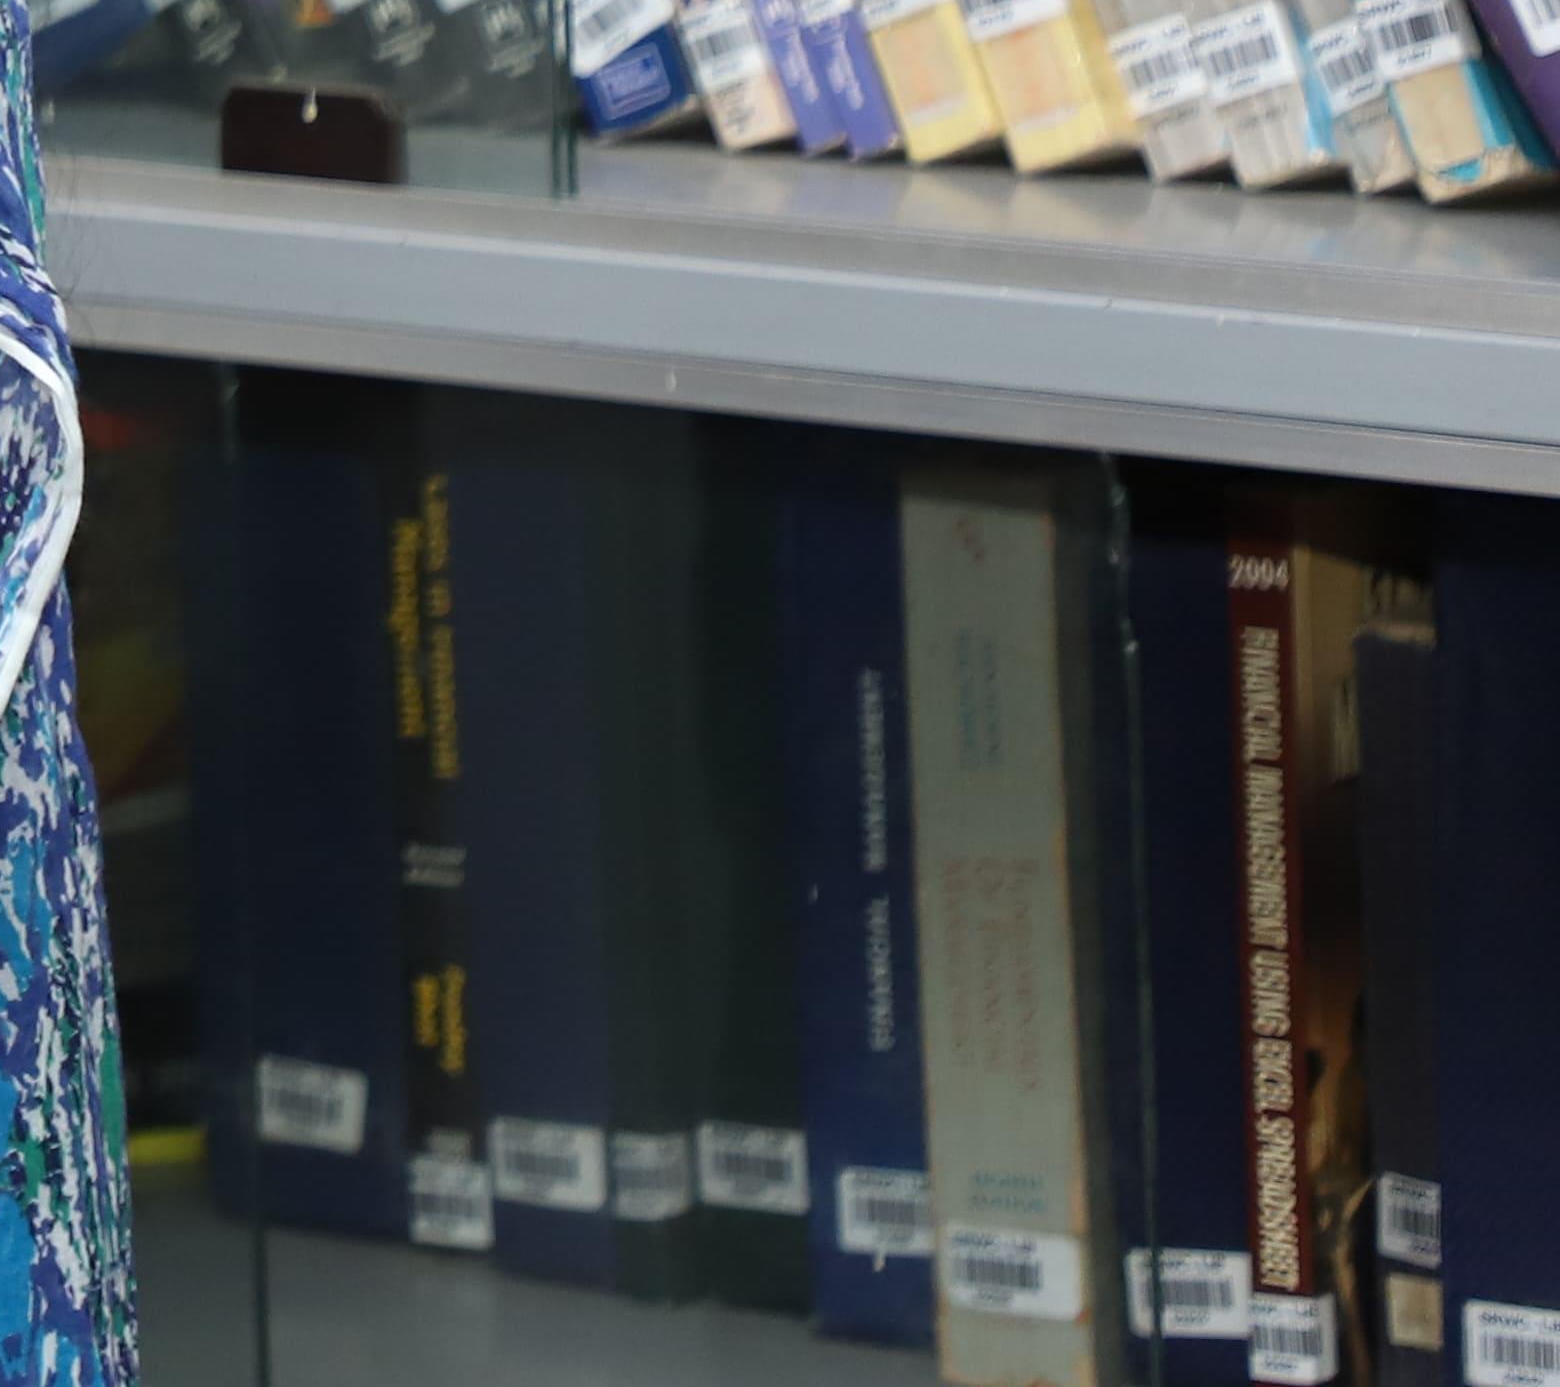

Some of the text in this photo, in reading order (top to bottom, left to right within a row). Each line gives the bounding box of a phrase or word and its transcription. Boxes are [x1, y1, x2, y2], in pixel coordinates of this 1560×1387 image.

[1228, 553, 1291, 593] 2004
[1241, 626, 1300, 1292] FINANCIAL MANAGEMENT USING EXCEL SPREADSHEET
